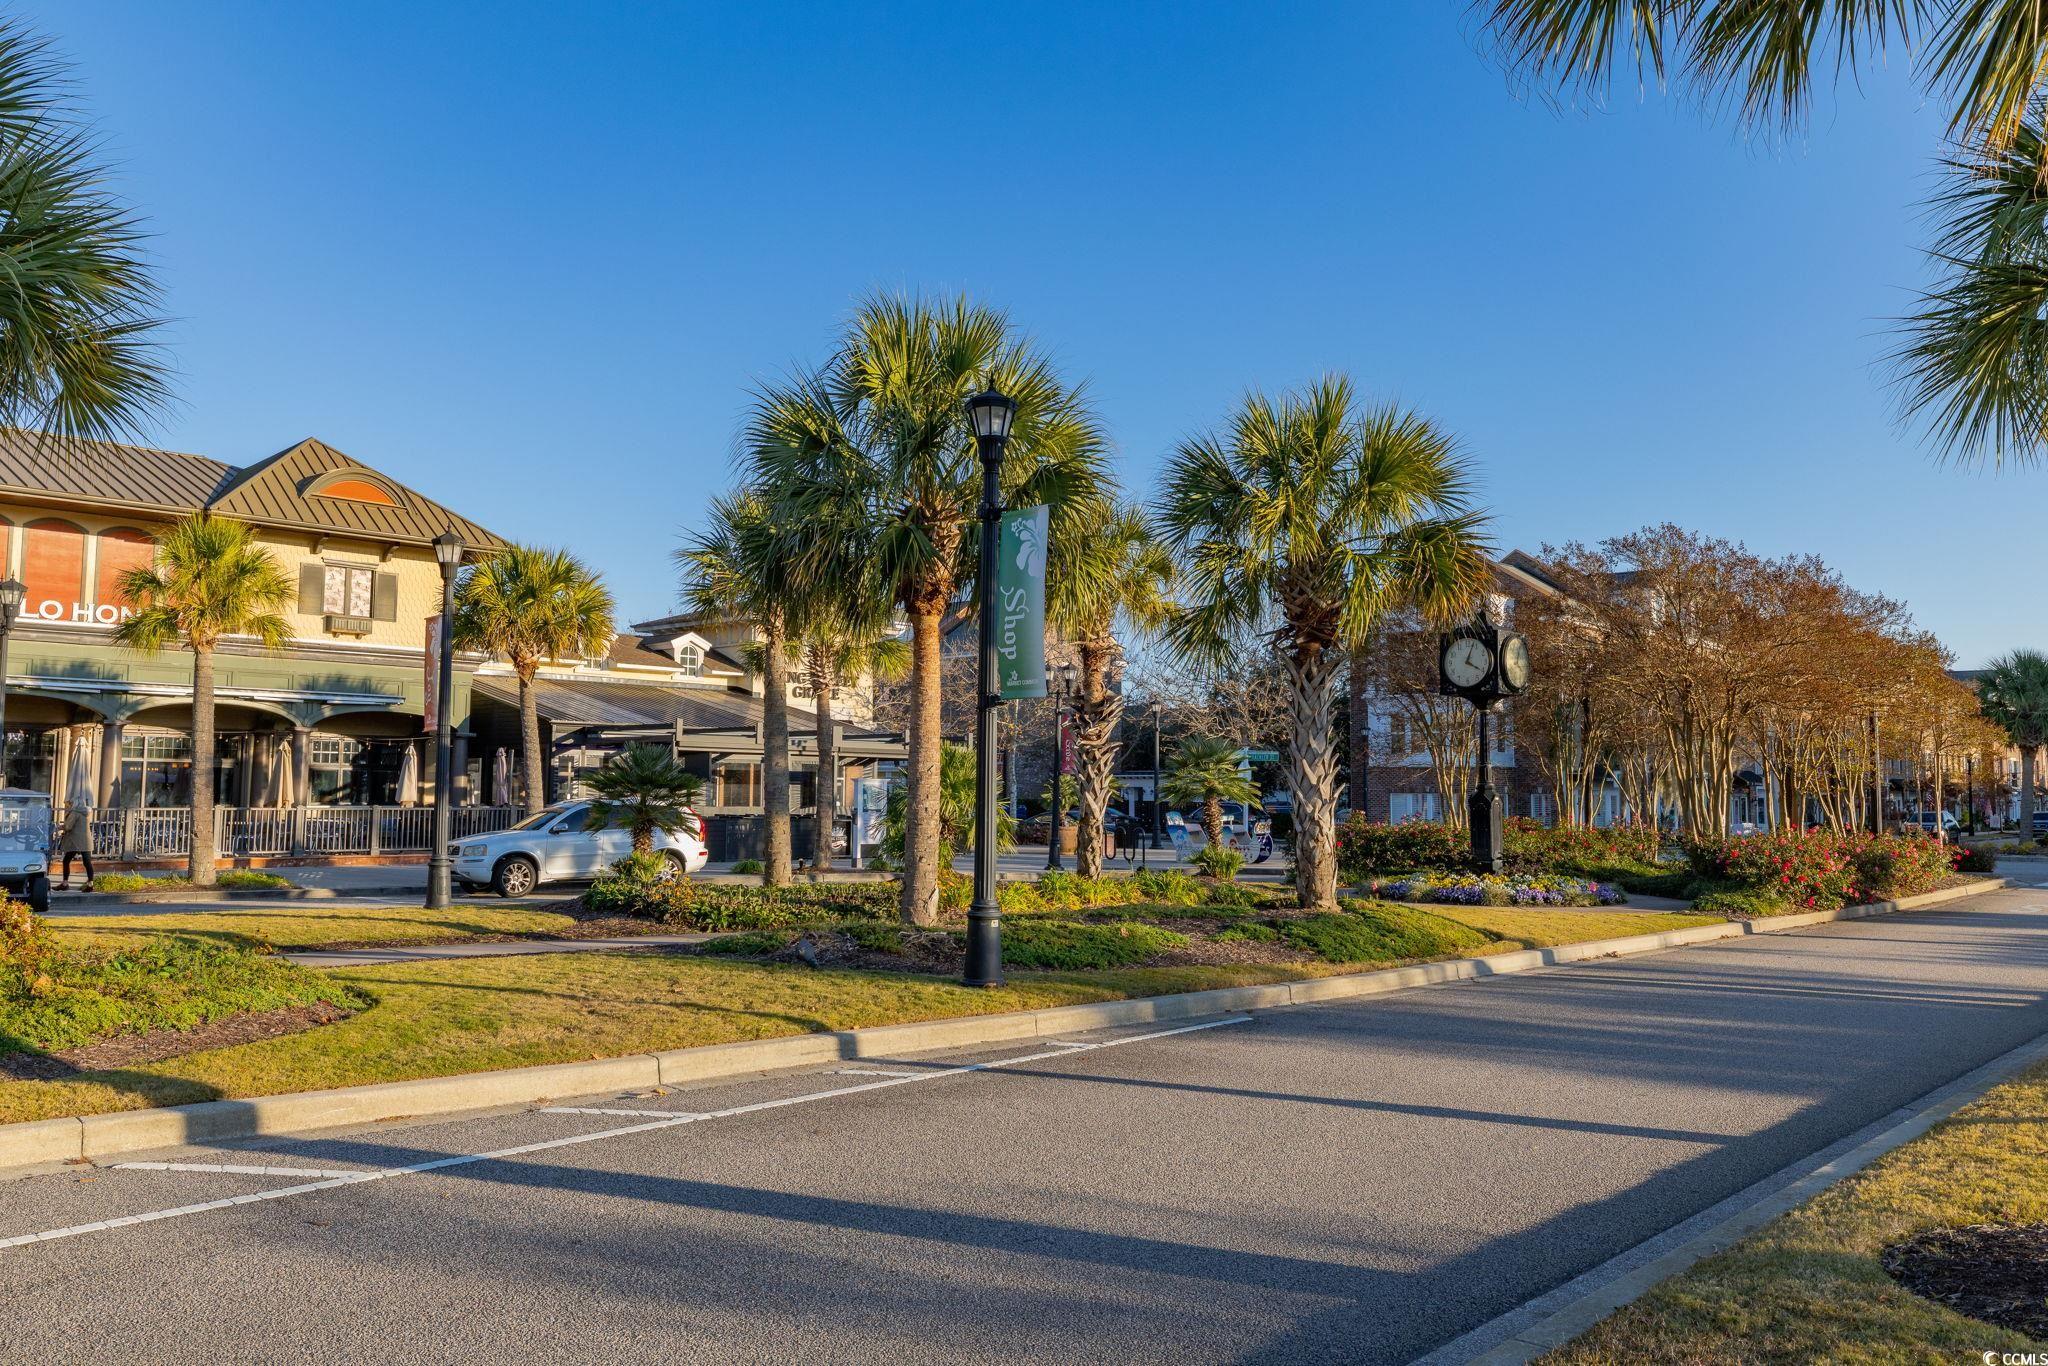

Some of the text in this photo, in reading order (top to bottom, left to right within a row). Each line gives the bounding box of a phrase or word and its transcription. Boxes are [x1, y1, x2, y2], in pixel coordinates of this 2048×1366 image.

[19, 598, 140, 623] LO HON
[998, 586, 1030, 660] Shop
